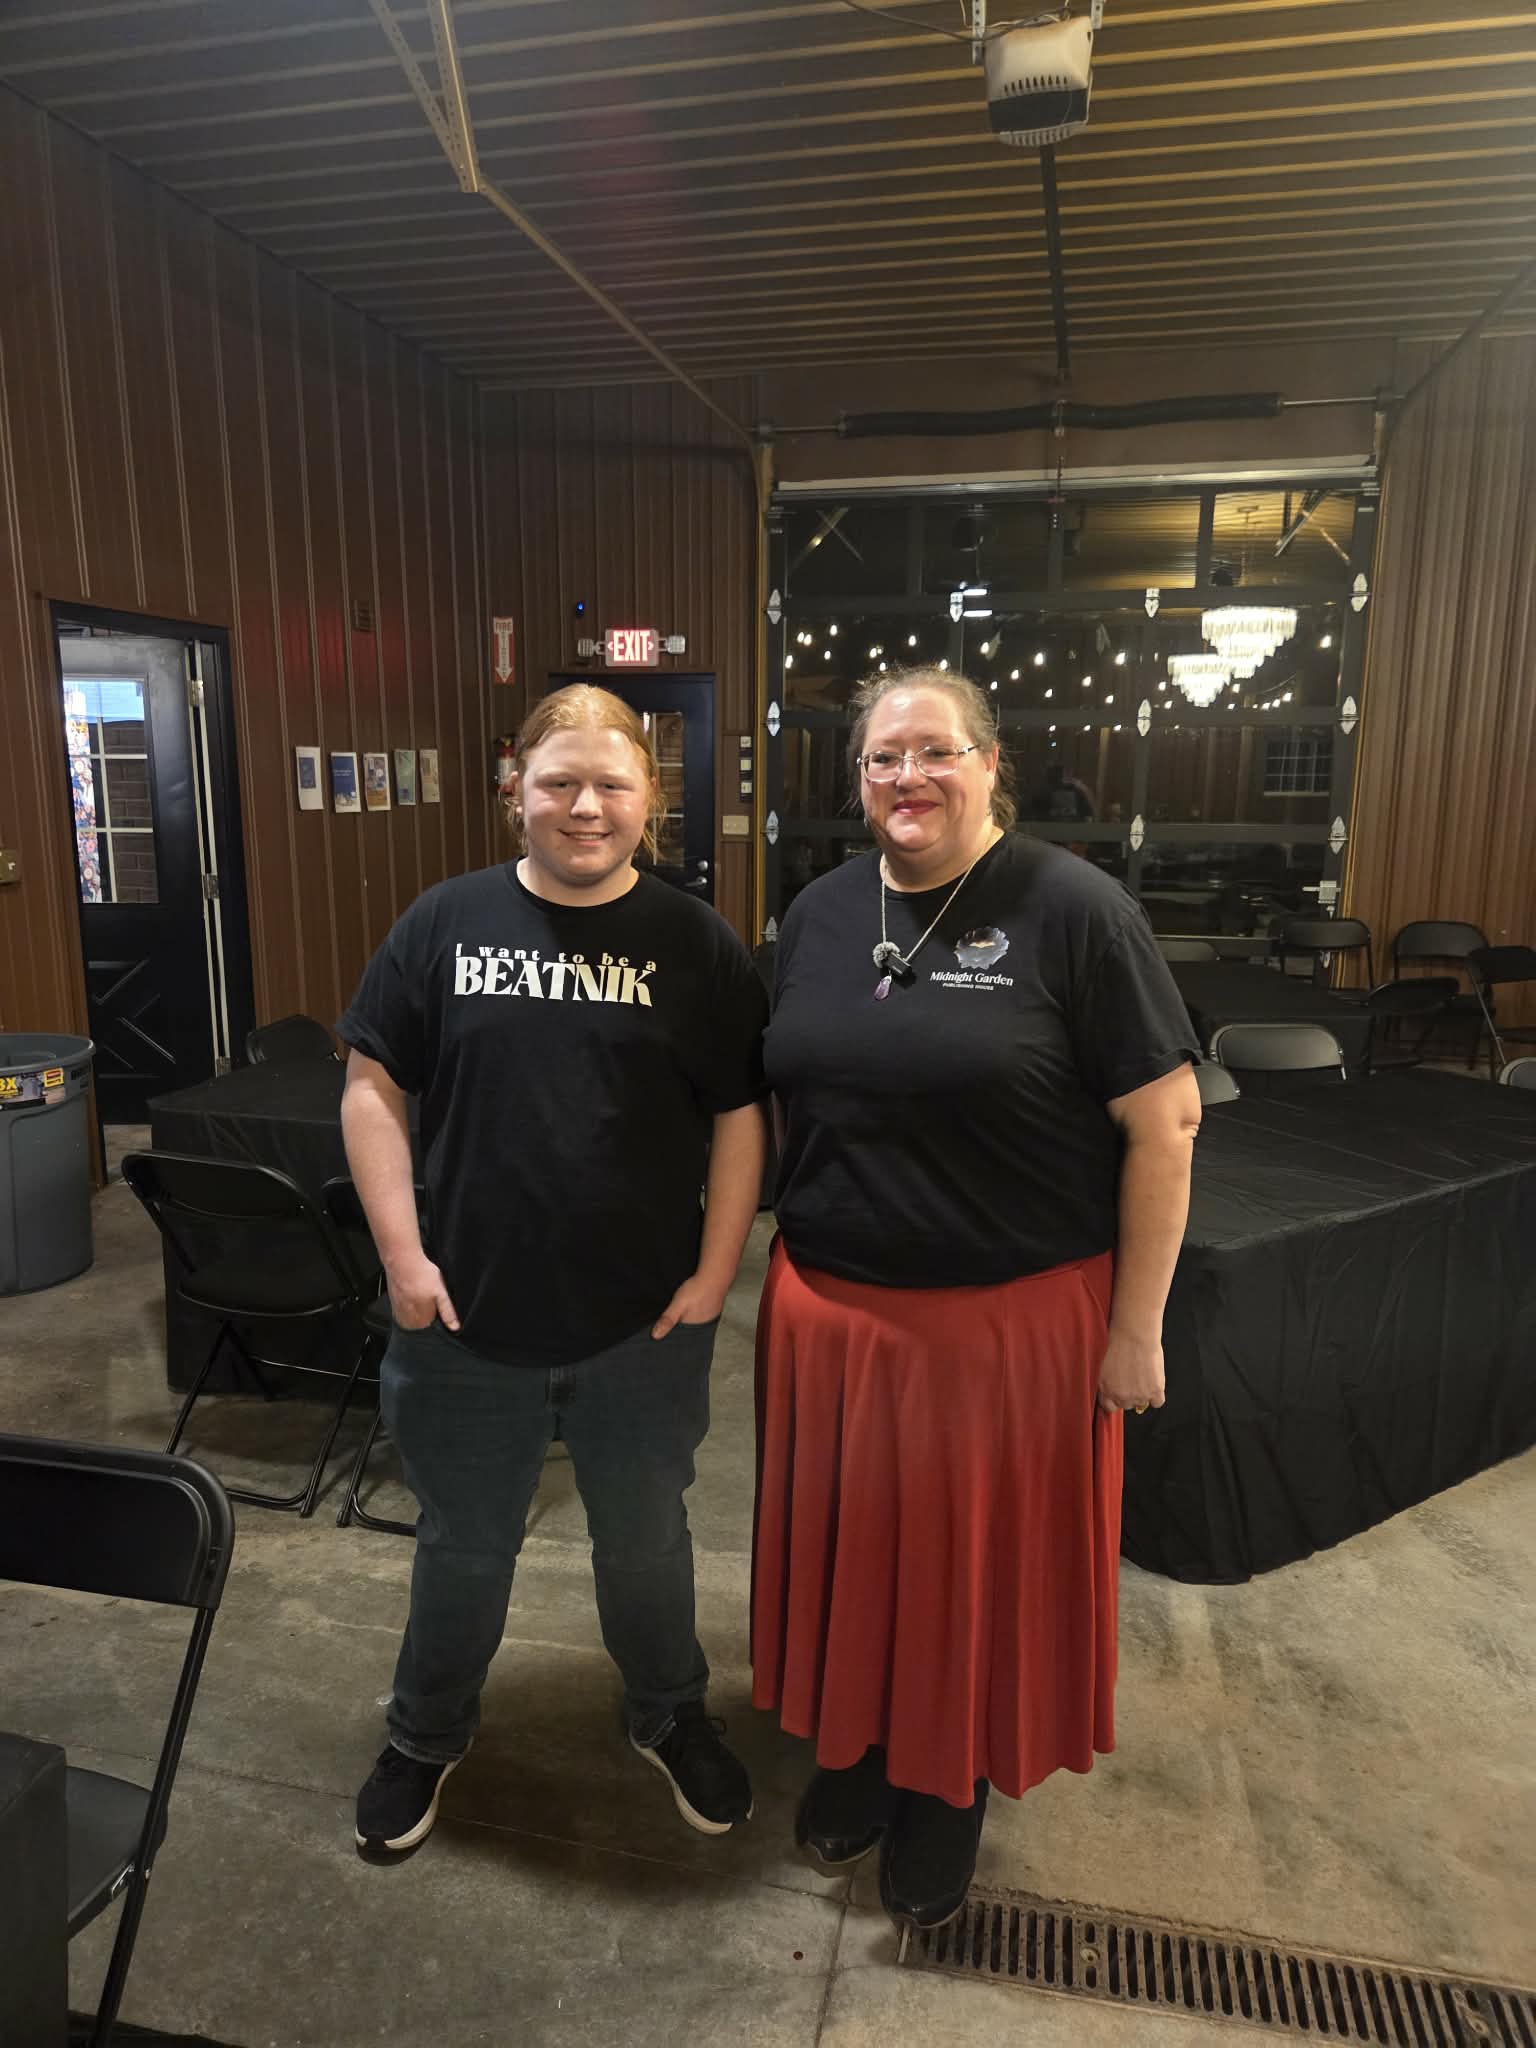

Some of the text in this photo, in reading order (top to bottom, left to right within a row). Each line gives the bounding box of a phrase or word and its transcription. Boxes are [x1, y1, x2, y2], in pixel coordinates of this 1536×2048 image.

[613, 629, 651, 662] EXIT
[456, 943, 657, 972] I want to be a
[454, 956, 654, 1008] BEATNIK
[929, 971, 974, 984] Midnight
[974, 972, 1014, 987] Garden
